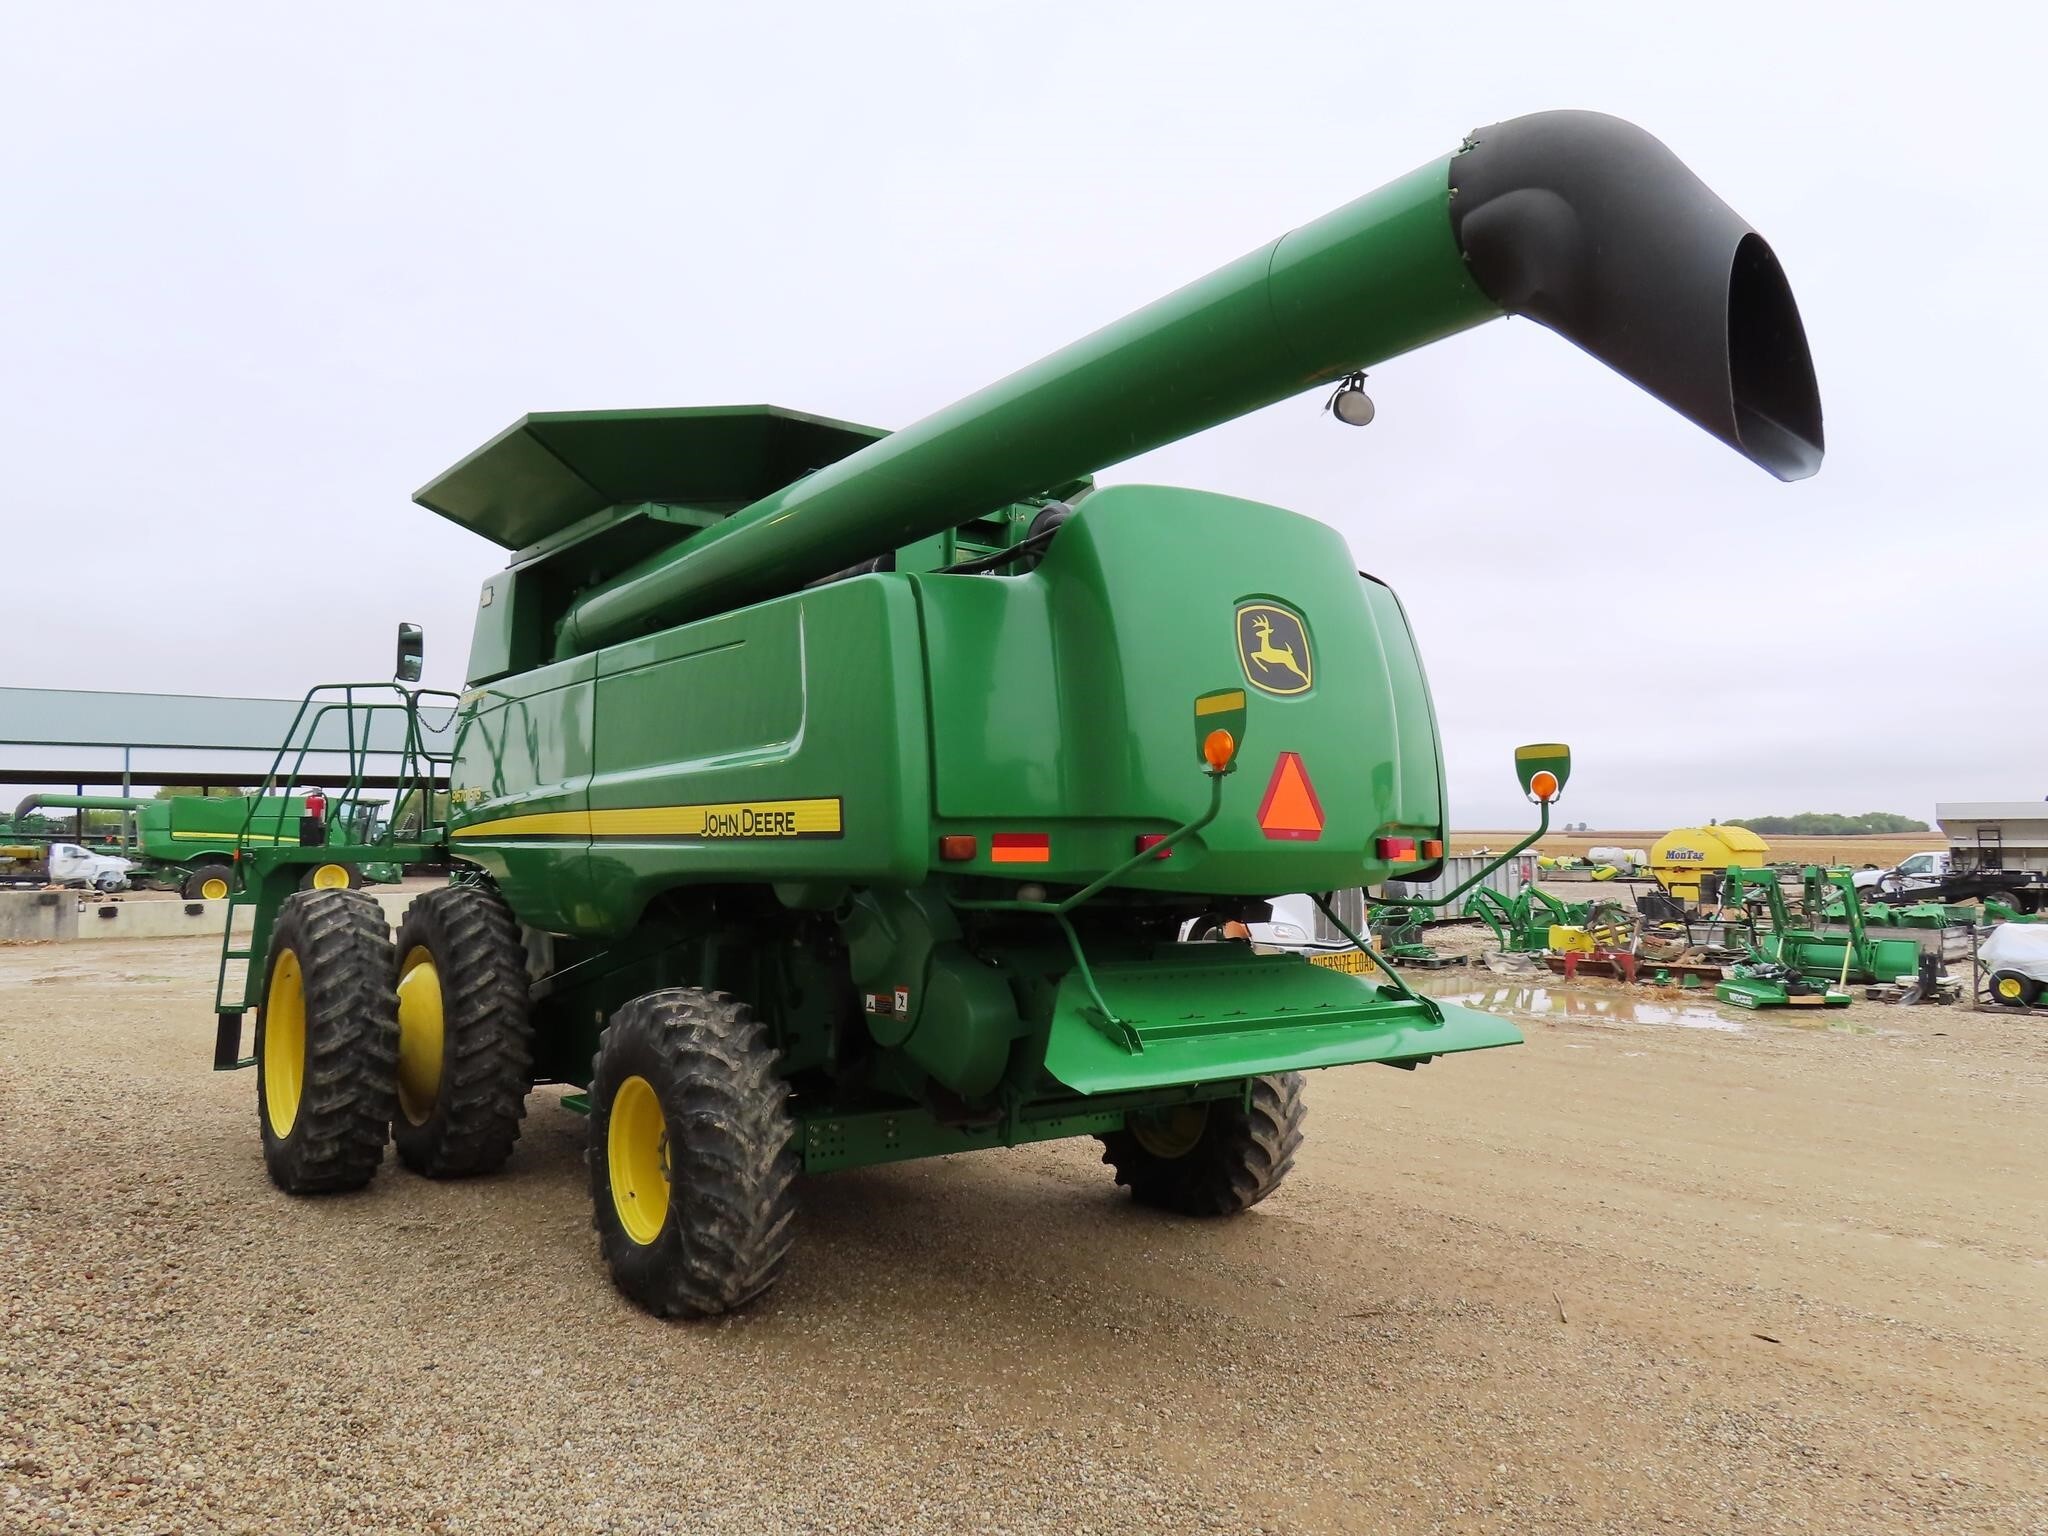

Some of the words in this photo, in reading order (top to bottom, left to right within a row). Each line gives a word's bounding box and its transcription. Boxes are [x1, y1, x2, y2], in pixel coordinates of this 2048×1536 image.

[701, 810, 739, 834] JOHN
[742, 809, 796, 833] DEERE
[1665, 850, 1704, 861] MonTag
[1354, 952, 1375, 973] LOAD
